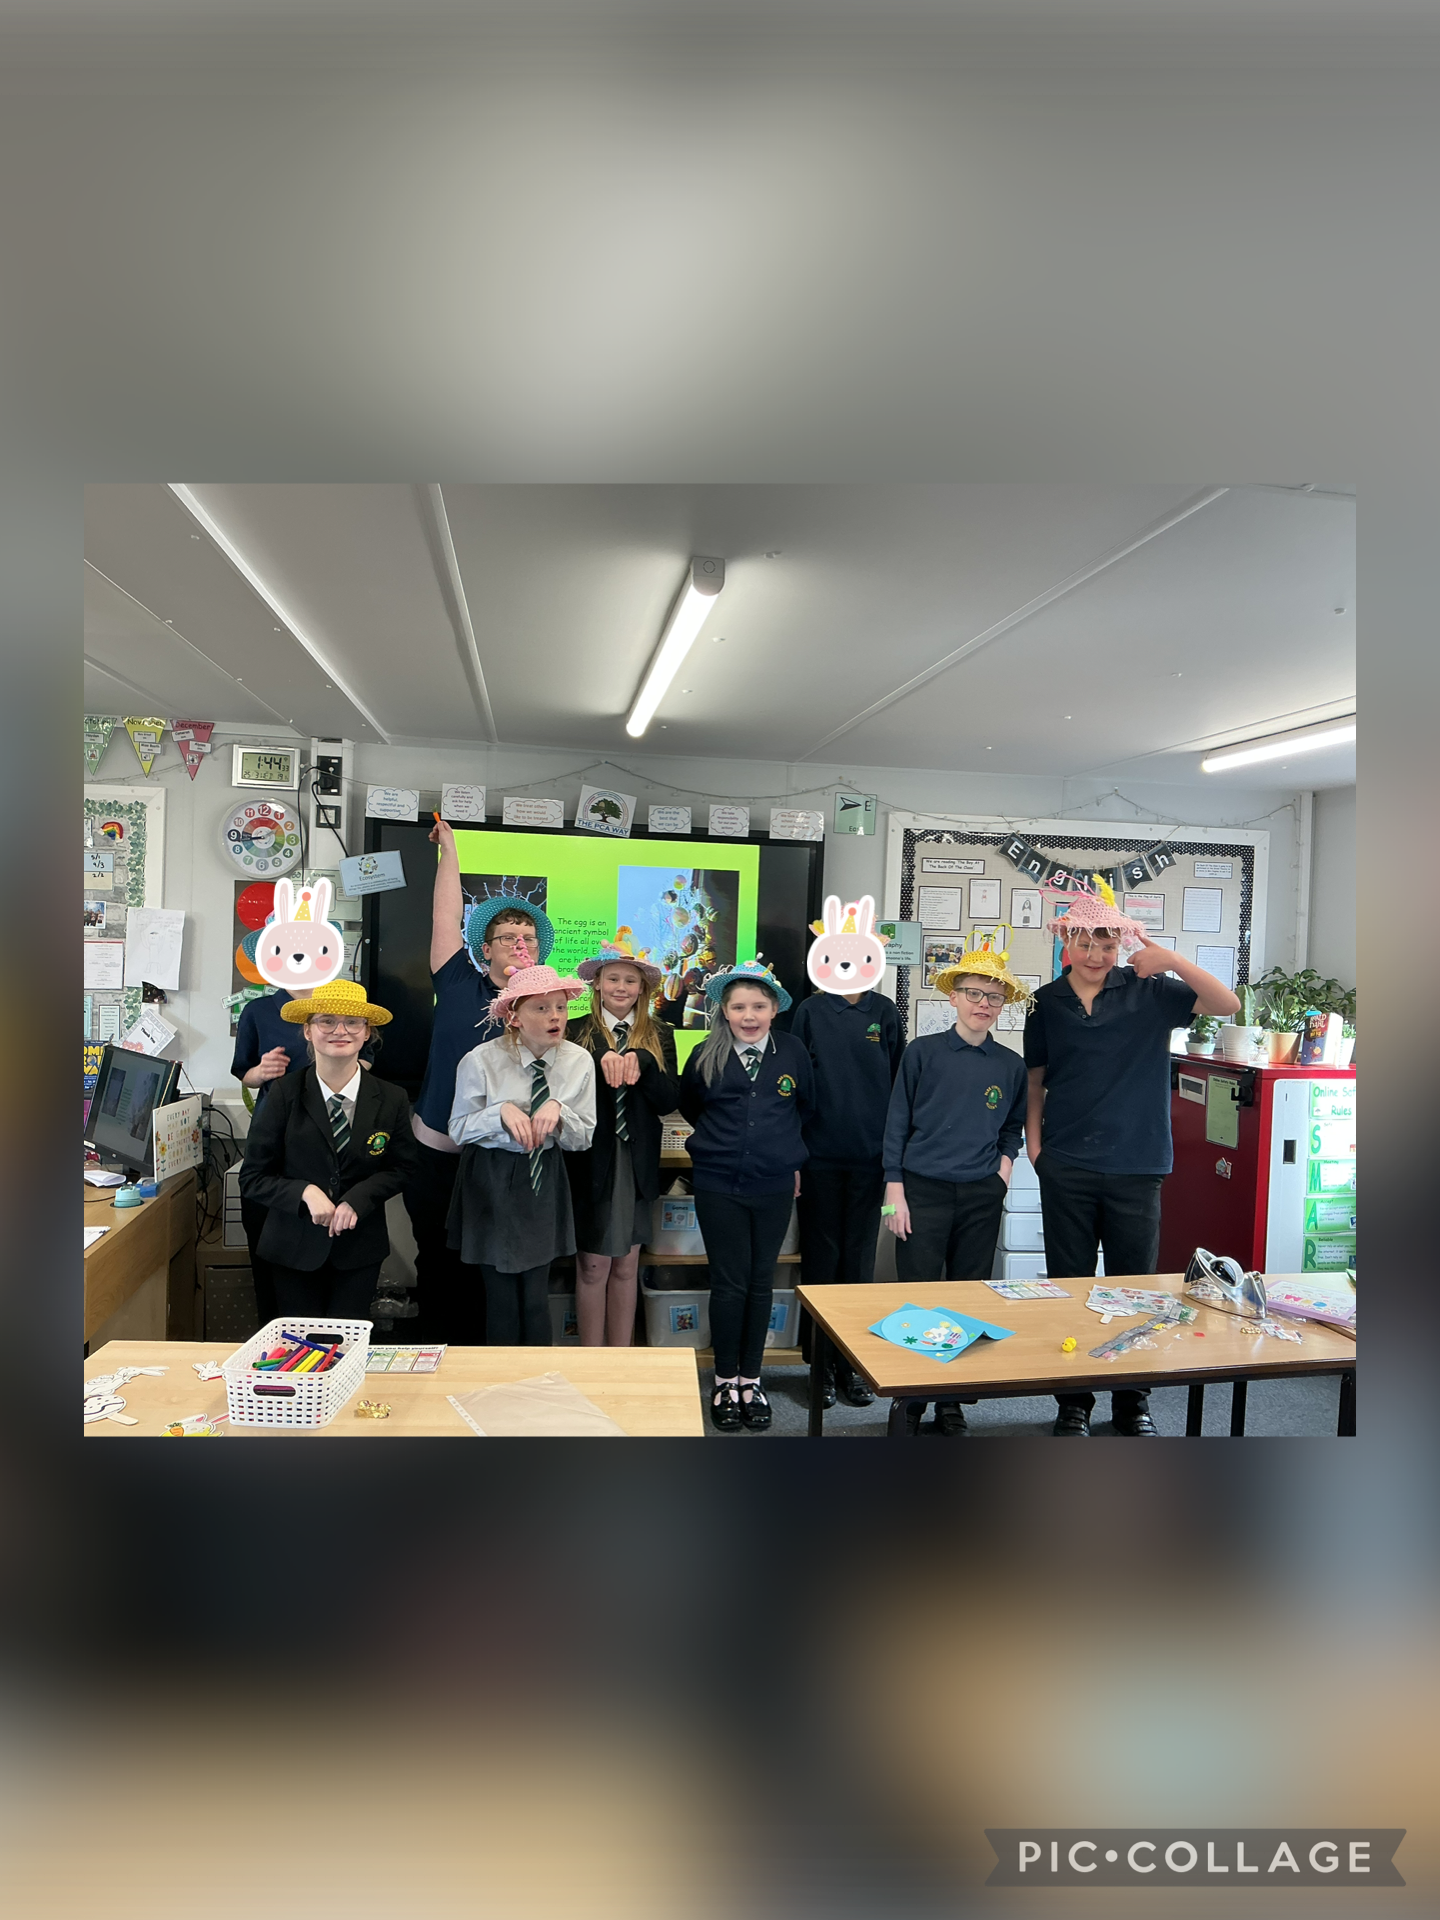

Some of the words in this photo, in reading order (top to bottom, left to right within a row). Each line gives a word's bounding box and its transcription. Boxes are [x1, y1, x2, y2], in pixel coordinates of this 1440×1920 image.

[175, 721, 211, 730] December
[257, 755, 283, 771] 1:44
[259, 806, 270, 816] 12
[864, 801, 872, 812] E
[245, 809, 254, 817] 11
[234, 818, 243, 826] 10
[578, 819, 592, 829] THE
[594, 821, 611, 832] PCA
[612, 826, 629, 836] WAY
[230, 831, 238, 840] 9
[289, 835, 296, 846] 3
[245, 857, 251, 865] 7
[274, 858, 280, 866] 5
[1007, 841, 1170, 892] English
[558, 917, 572, 925] The
[565, 937, 578, 945] life
[1313, 1086, 1338, 1098] Online
[1342, 1086, 1356, 1097] Saf
[166, 1111, 180, 1122] EVERY
[181, 1108, 190, 1117] DAY
[1331, 1105, 1352, 1116] Rules
[180, 1116, 190, 1127] NOT
[167, 1132, 174, 1142] BE
[1311, 1124, 1322, 1154] S
[168, 1158, 182, 1169] EVERY
[1310, 1162, 1322, 1192] M
[1306, 1201, 1318, 1231] A
[1304, 1239, 1317, 1269] R
